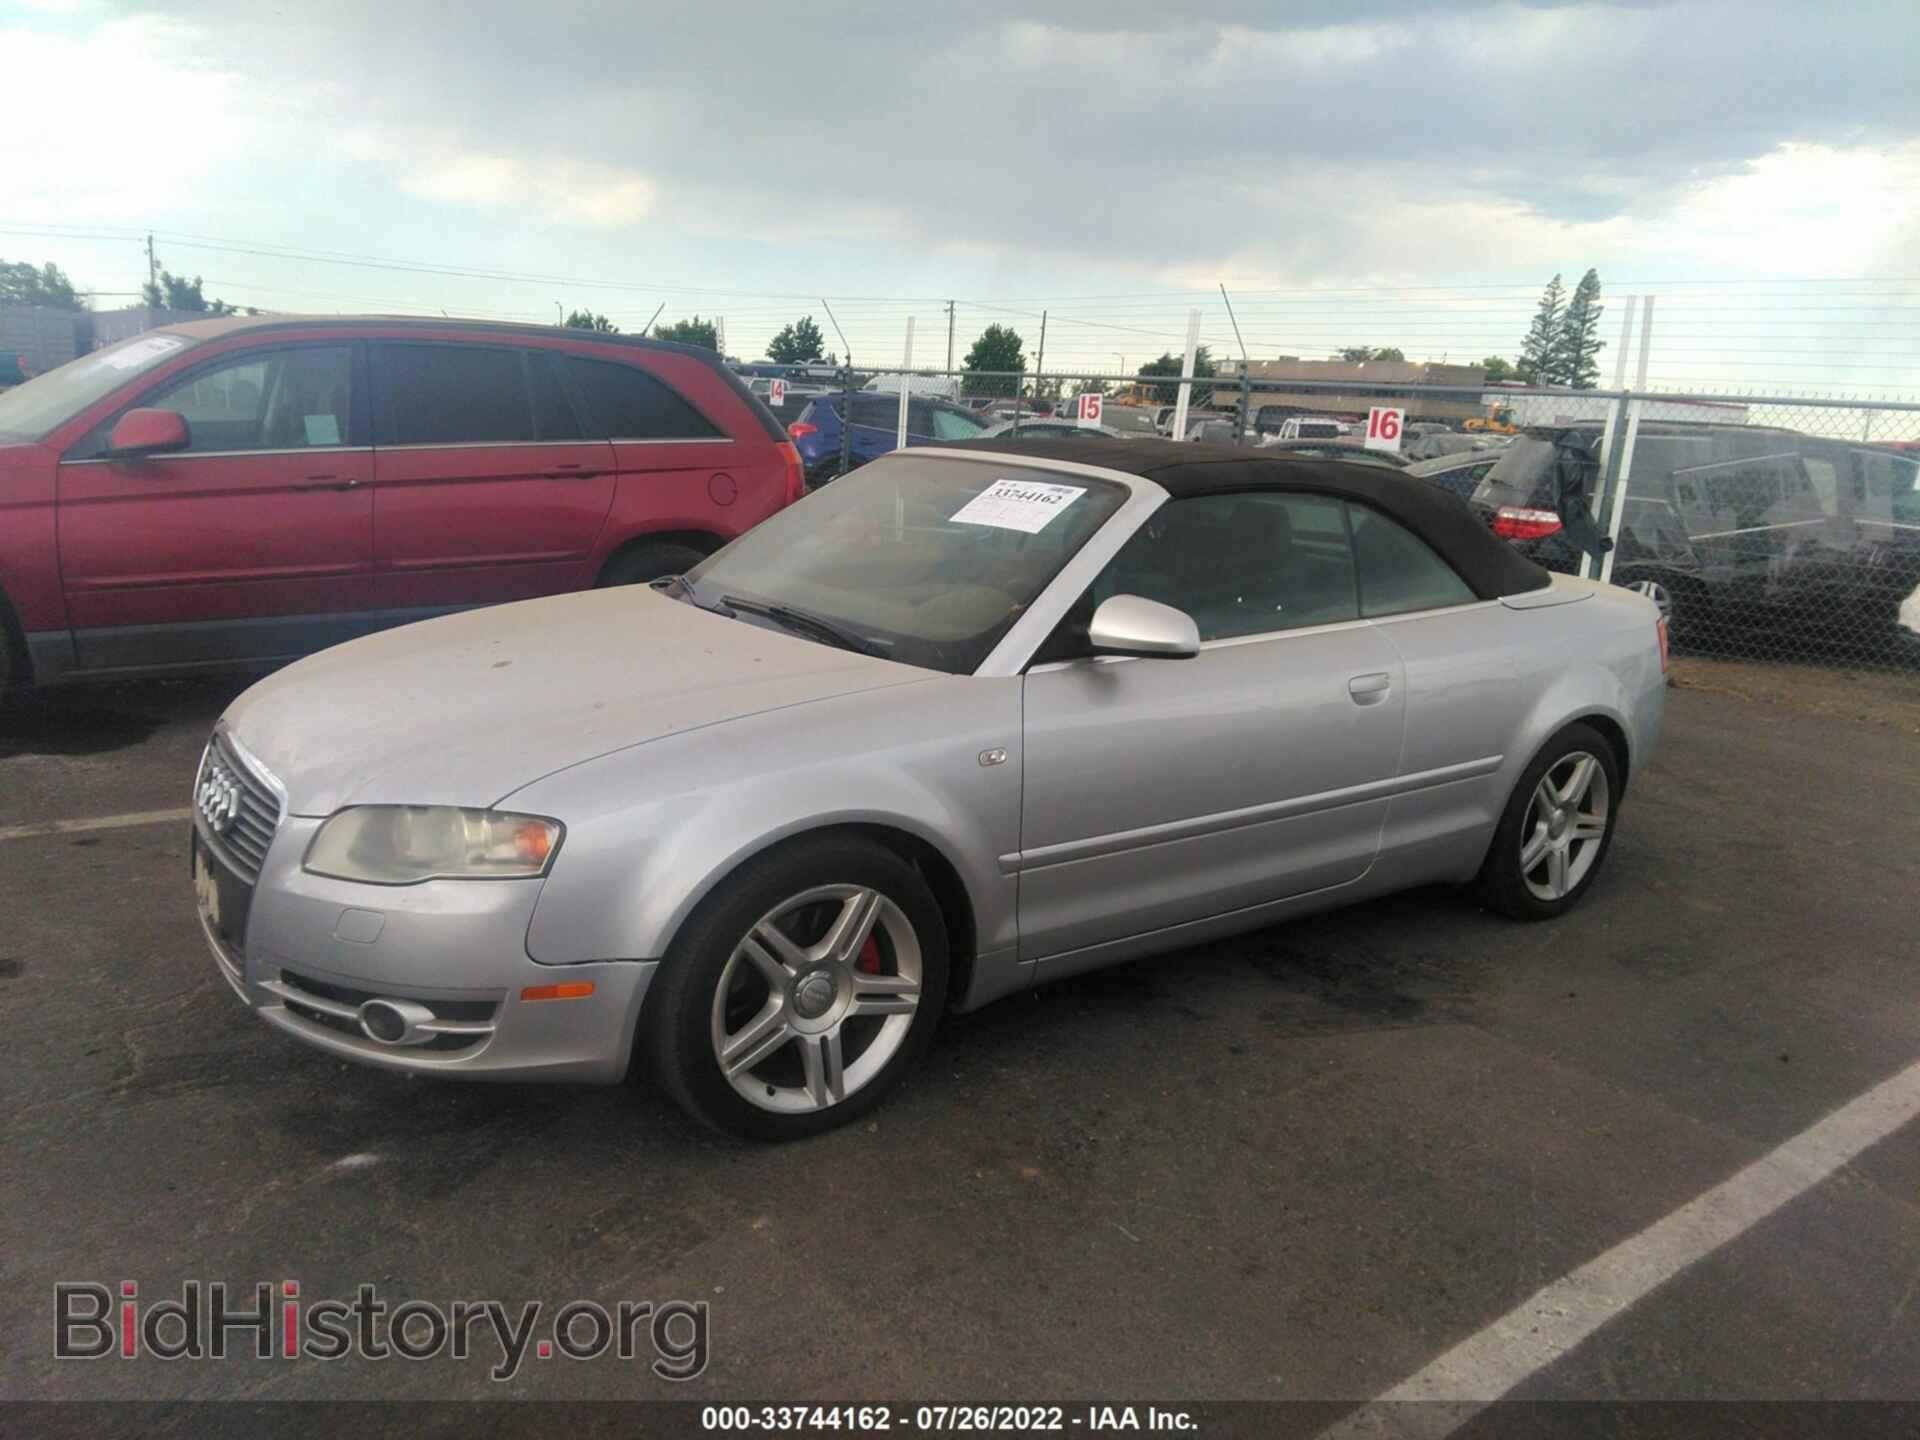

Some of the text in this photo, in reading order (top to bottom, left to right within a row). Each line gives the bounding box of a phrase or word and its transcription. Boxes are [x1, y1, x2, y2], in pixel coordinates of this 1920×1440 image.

[771, 380, 783, 398] 14
[1080, 395, 1100, 419] 15
[1369, 409, 1399, 440] 16
